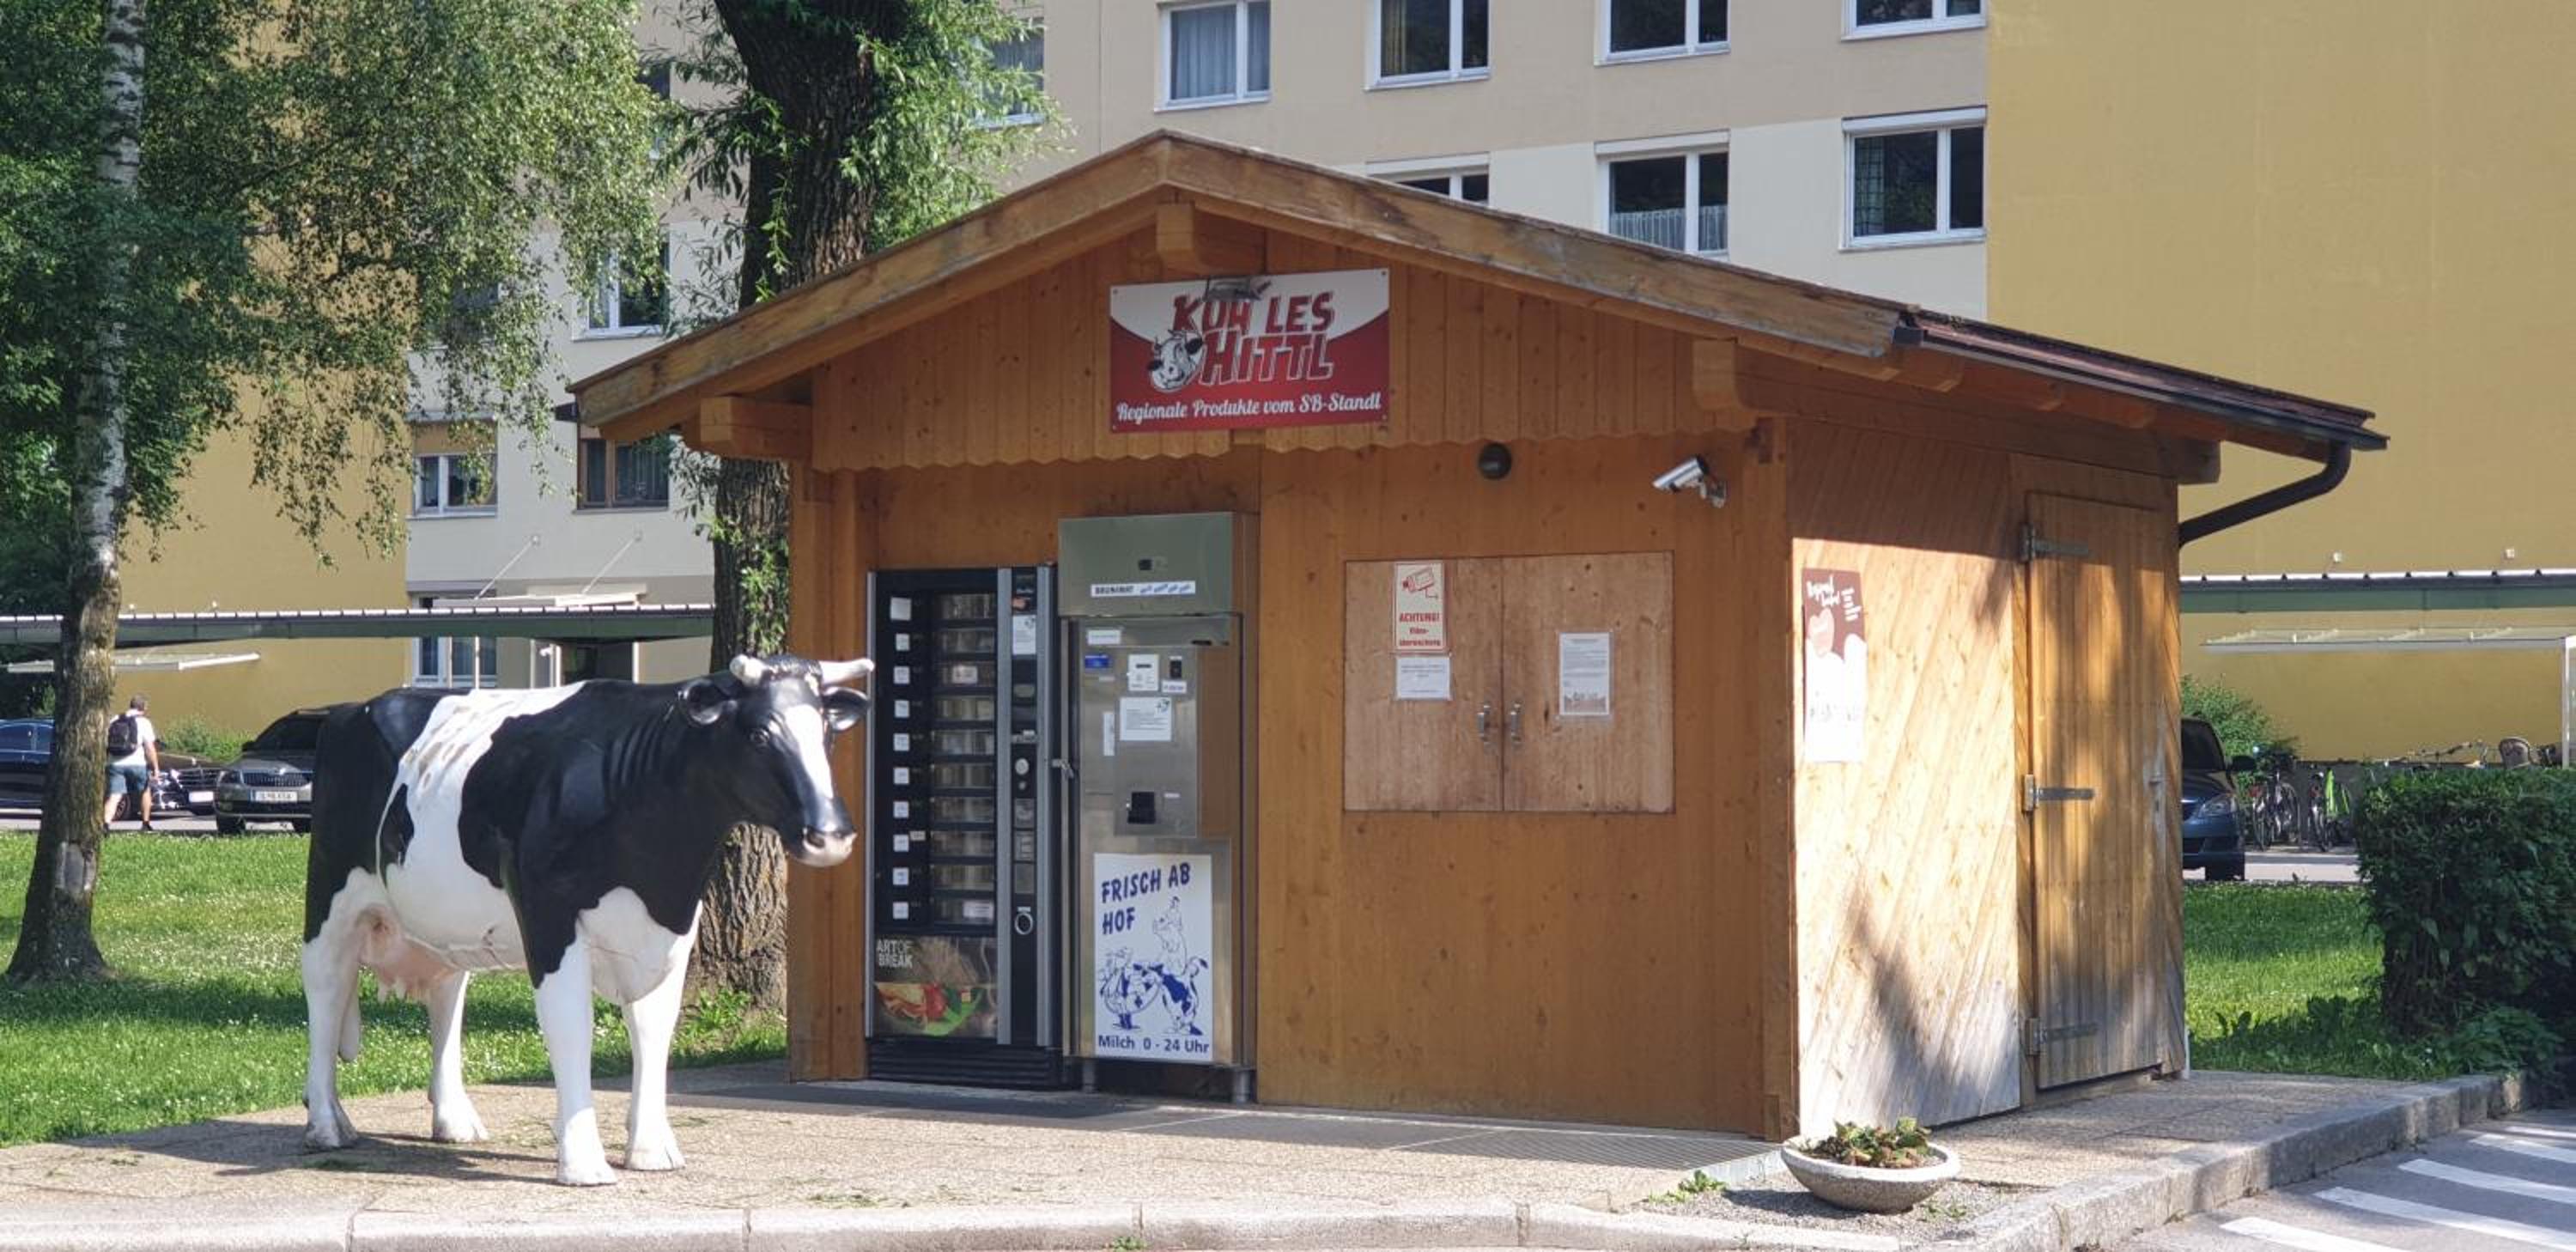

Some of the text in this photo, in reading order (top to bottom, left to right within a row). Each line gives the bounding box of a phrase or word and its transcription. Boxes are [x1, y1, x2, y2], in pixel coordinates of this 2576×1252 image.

[1265, 291, 1336, 334] LES
[1199, 328, 1335, 386] HITTL
[1117, 391, 1382, 425] Regionale Produkte vom SB-Standl
[1399, 612, 1440, 623] ACHTUNG!
[1101, 862, 1191, 903] FRISCH AB
[1103, 907, 1136, 935] HOF
[878, 953, 913, 969] BREAK
[1098, 1035, 1135, 1050] Milch
[1143, 1036, 1151, 1050] 0
[1164, 1036, 1181, 1051] 24
[1184, 1040, 1210, 1054] Uhr
